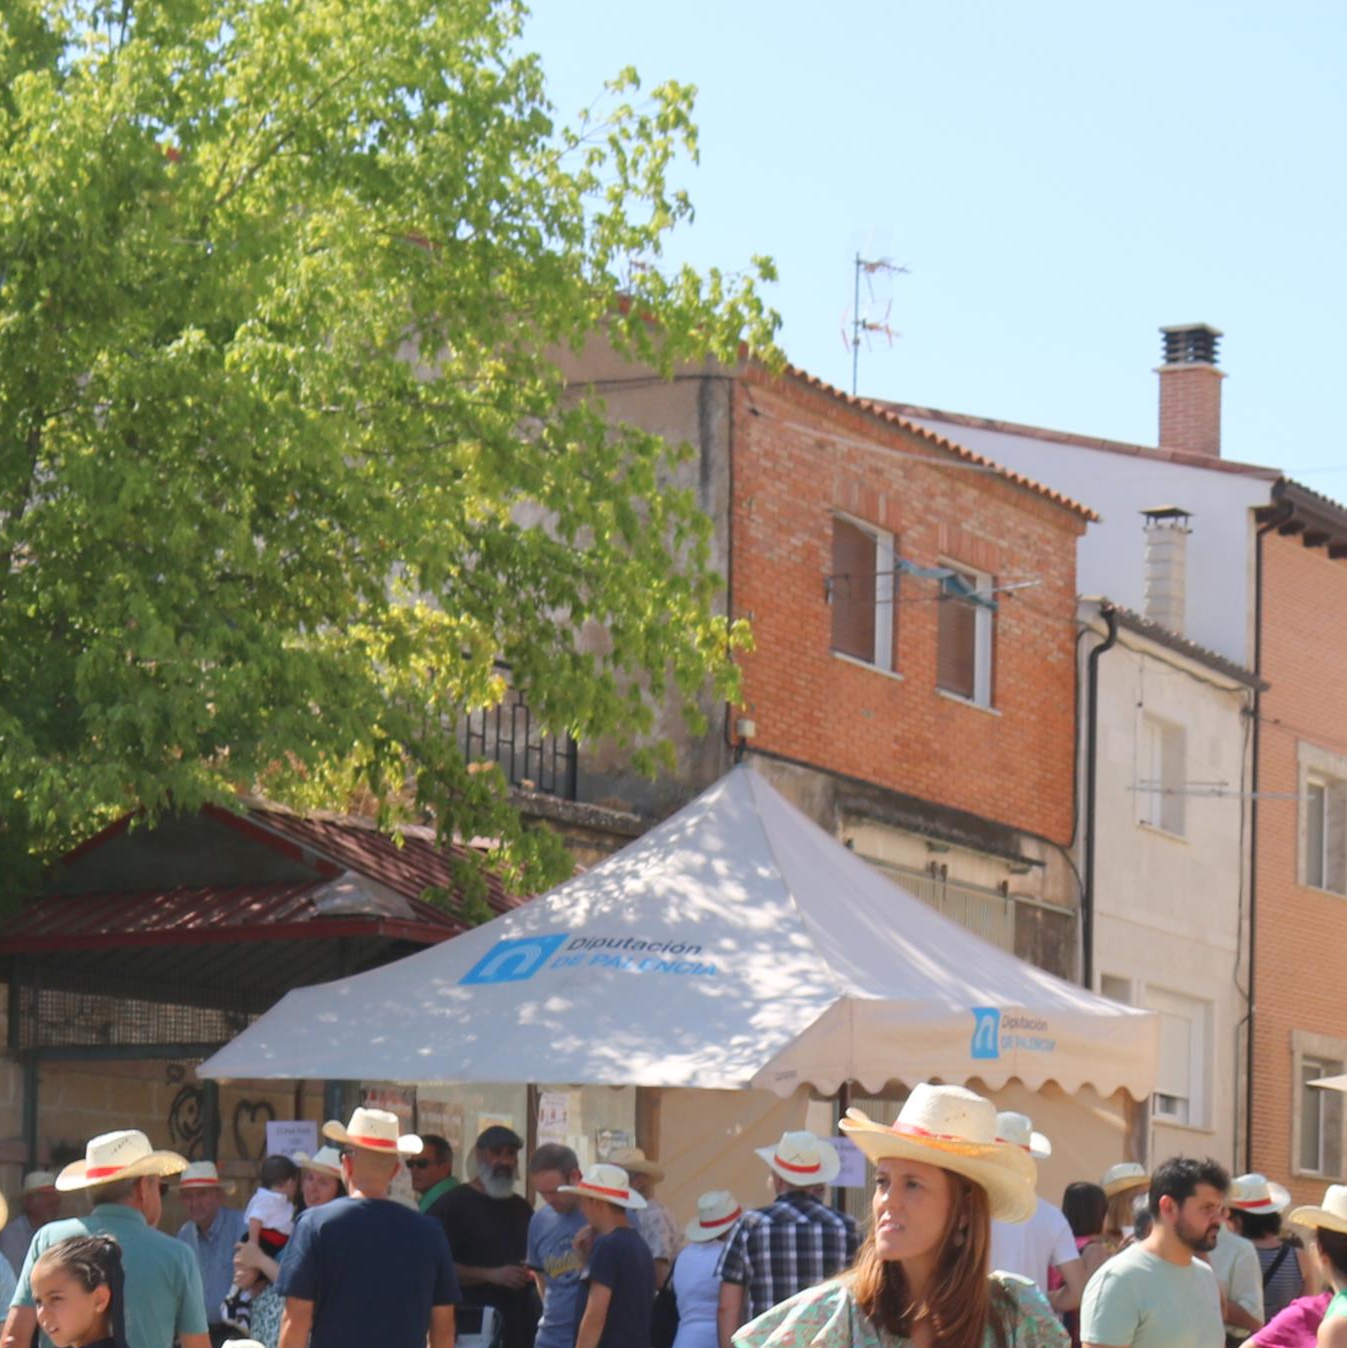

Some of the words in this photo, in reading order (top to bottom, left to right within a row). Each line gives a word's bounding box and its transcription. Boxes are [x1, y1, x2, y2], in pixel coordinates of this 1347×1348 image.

[567, 936, 703, 955] Diputación
[550, 953, 587, 969] DE
[588, 953, 717, 976] PALENCIA
